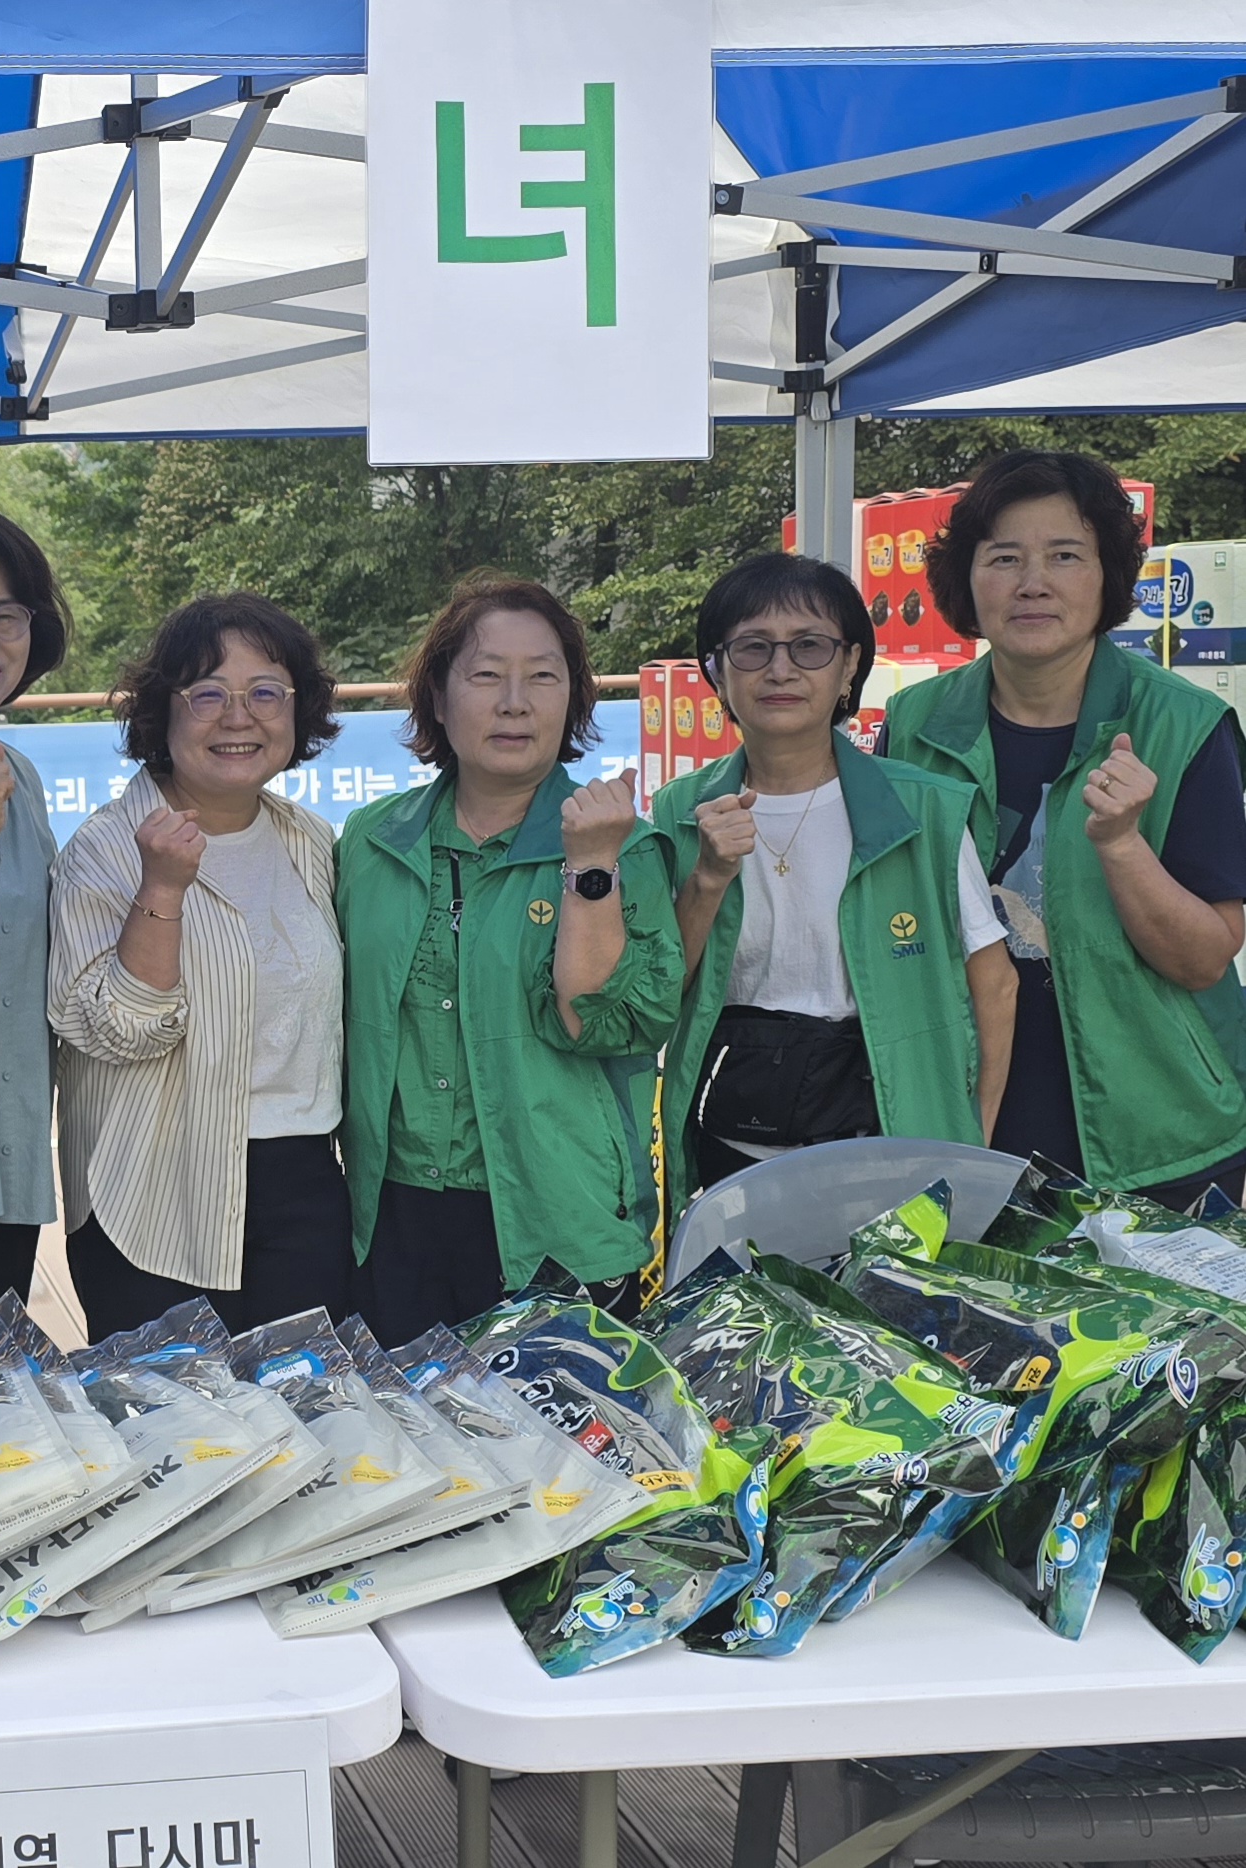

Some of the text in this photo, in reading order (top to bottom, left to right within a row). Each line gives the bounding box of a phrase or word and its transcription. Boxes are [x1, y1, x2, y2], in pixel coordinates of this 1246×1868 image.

[435, 82, 617, 327] 녀
[332, 766, 396, 803] 되는
[1199, 1536, 1221, 1566] Only
[352, 1577, 374, 1590] Only
[607, 1578, 637, 1603] Only
[750, 1570, 777, 1597] Only
[106, 1818, 260, 1868] 다시마
